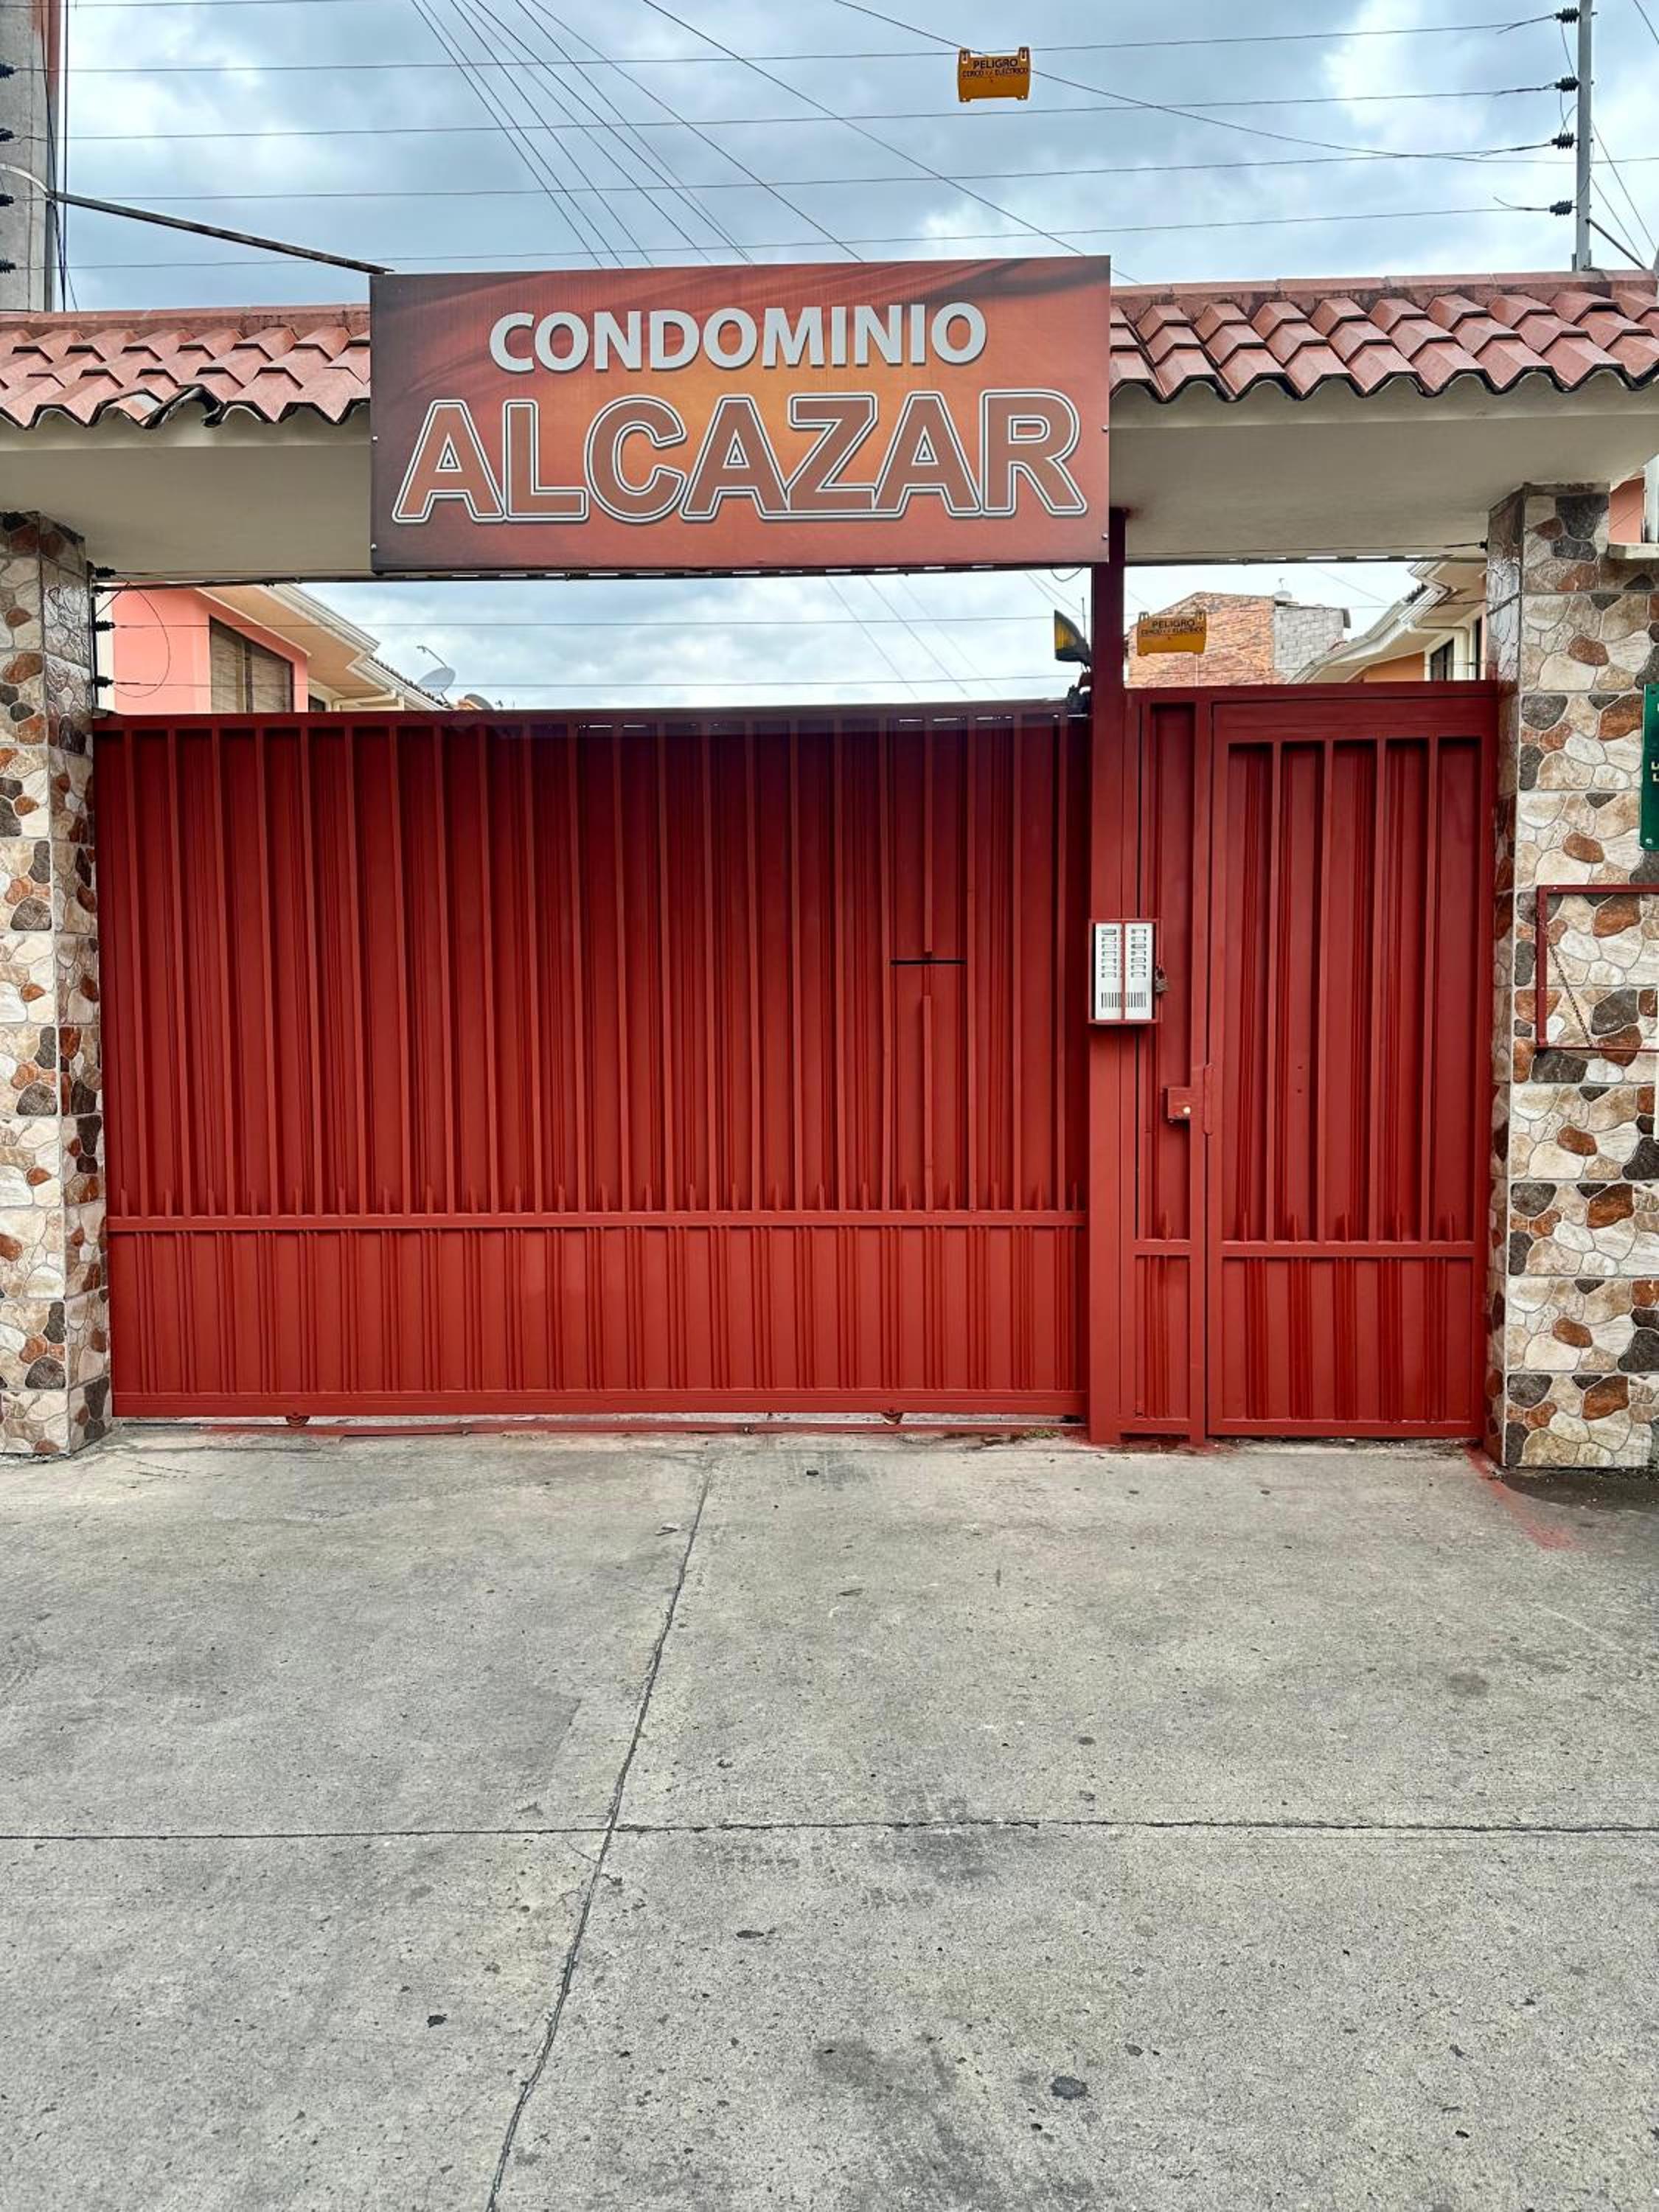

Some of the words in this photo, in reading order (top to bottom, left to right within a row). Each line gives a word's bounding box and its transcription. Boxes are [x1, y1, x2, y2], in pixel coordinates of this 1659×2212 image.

[973, 58, 1018, 69] PELIGRO
[489, 302, 987, 372] CONDOMINIO
[391, 389, 1089, 524] ALCAZAR
[1152, 619, 1195, 629] PELIGRO
